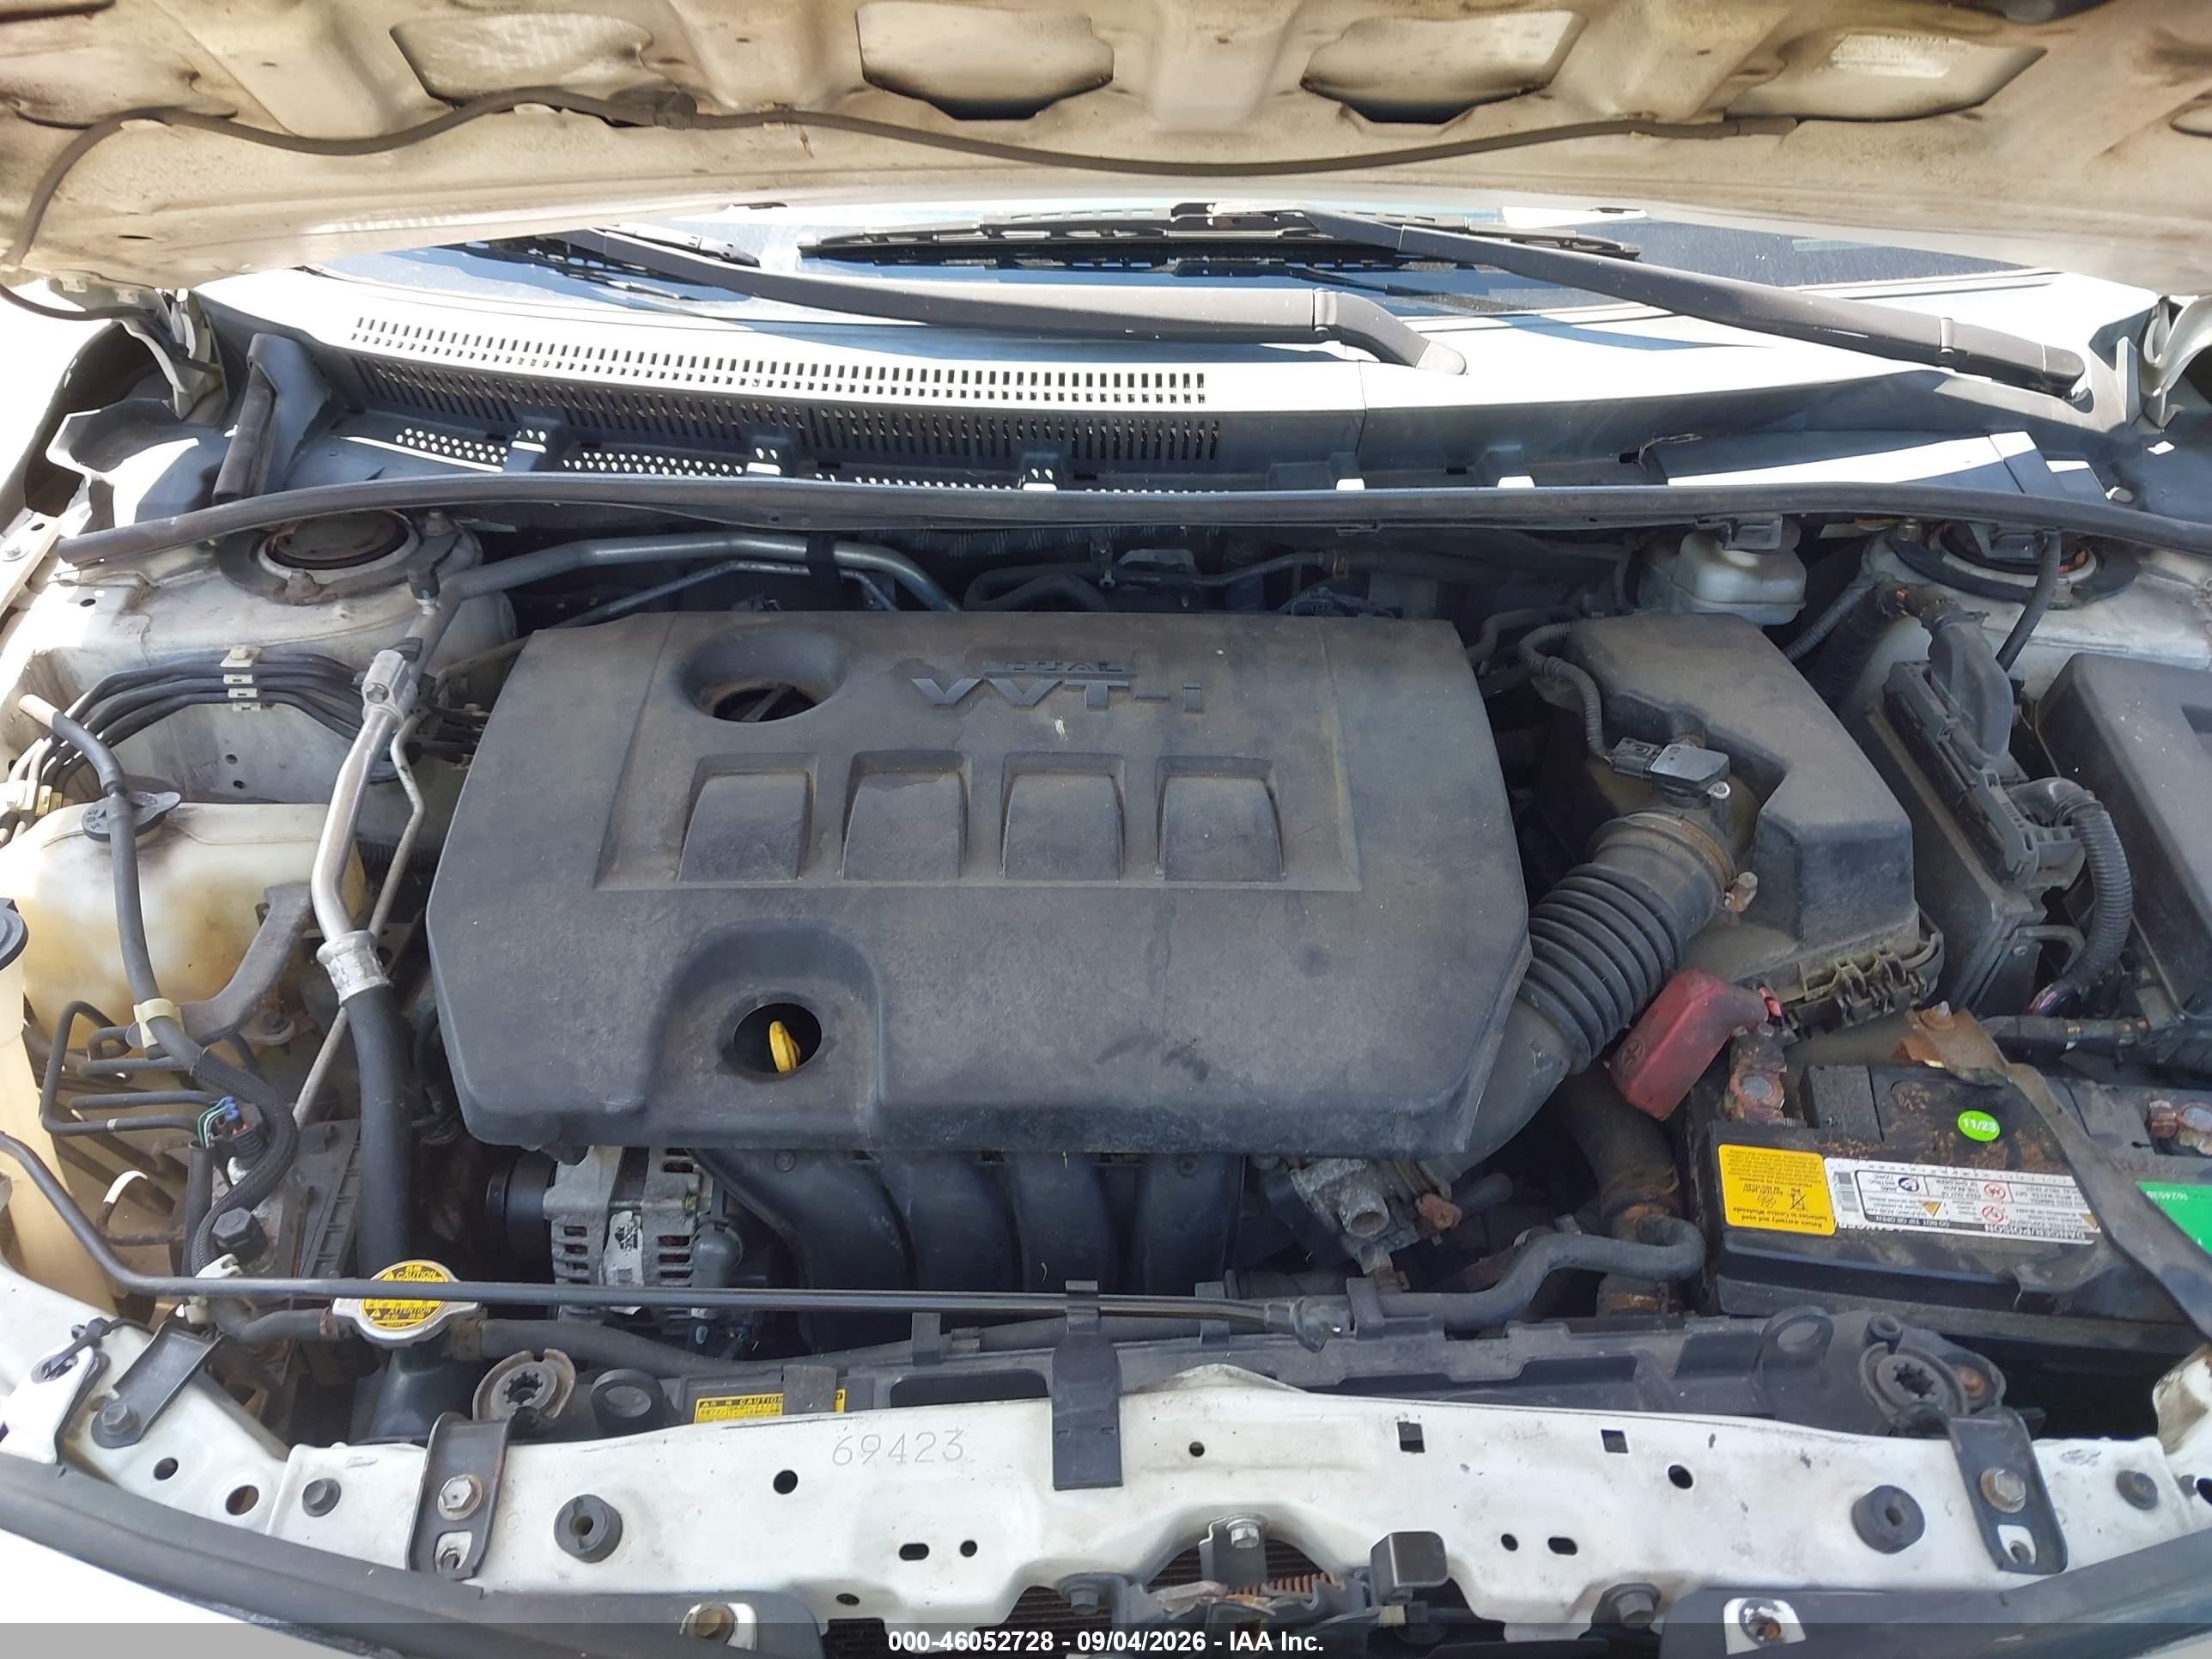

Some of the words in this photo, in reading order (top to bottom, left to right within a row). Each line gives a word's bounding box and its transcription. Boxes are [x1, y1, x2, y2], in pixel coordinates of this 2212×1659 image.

[1963, 1118, 1996, 1133] 11/23
[397, 1270, 436, 1279] CAUTION
[389, 1306, 432, 1315] ATTENTION
[831, 1430, 964, 1467] 69423
